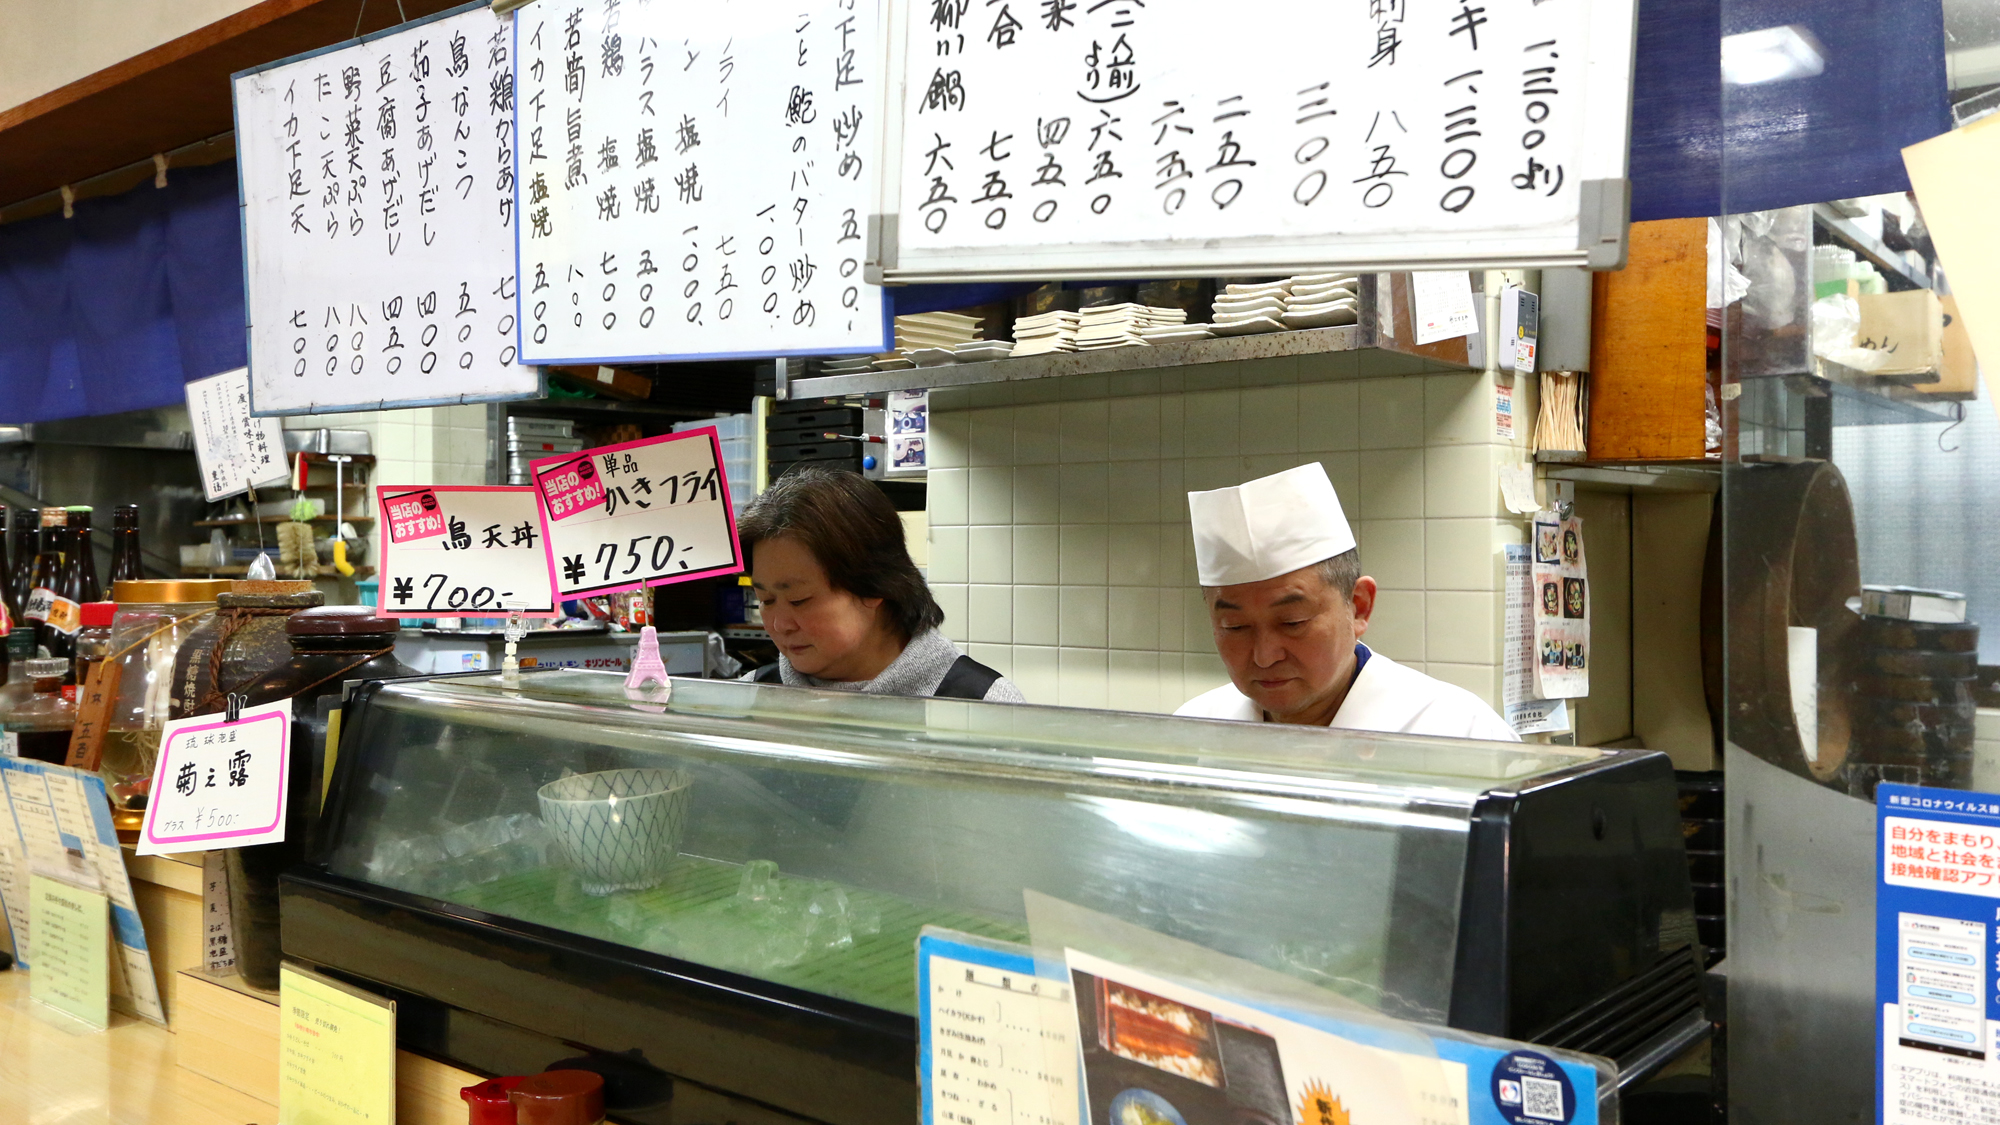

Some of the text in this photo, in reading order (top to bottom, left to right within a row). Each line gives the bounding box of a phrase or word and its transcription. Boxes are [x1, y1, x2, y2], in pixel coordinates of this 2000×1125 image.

[604, 453, 639, 479] 単品
[545, 471, 579, 497] 当店の
[603, 468, 719, 516] かきフライ
[390, 501, 423, 520] 当店の
[176, 749, 252, 797] 菊之露
